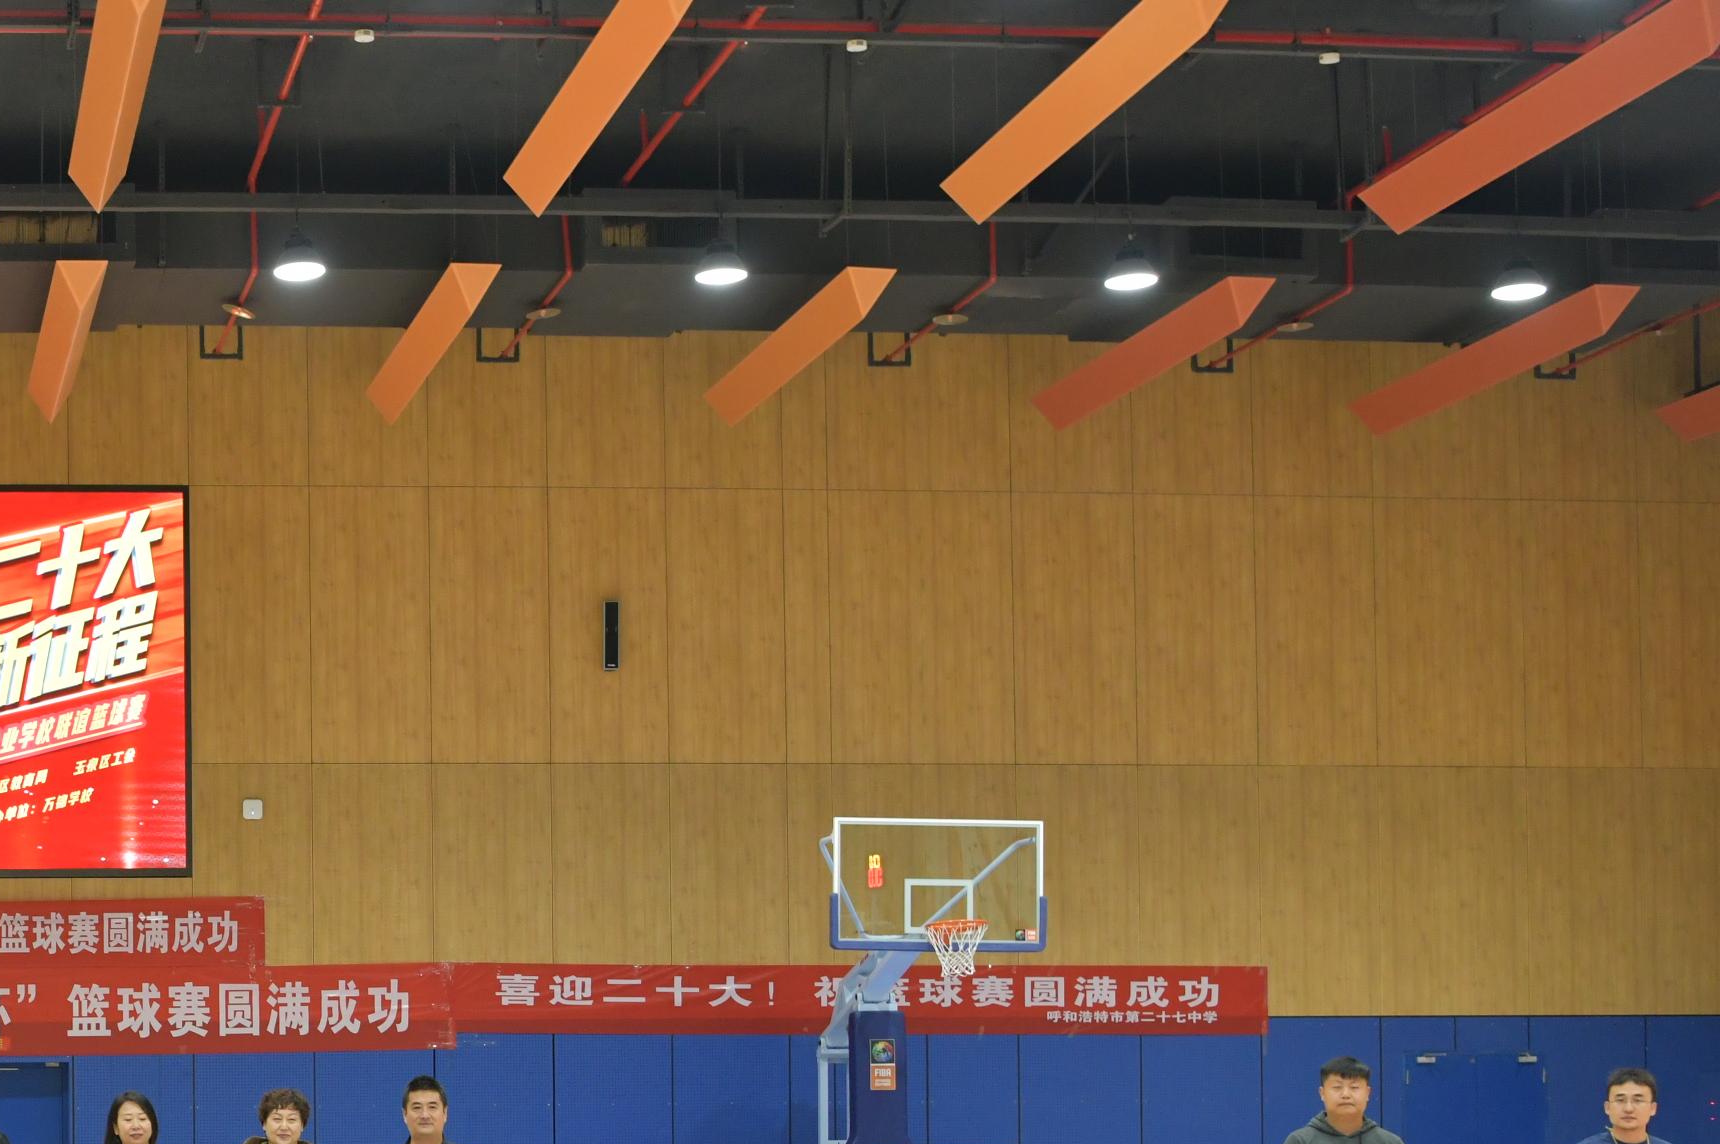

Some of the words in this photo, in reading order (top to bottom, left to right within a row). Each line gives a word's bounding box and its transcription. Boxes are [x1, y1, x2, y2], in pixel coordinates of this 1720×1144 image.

[1047, 1010, 1218, 1023] 呼和浩特市第二十七中学
